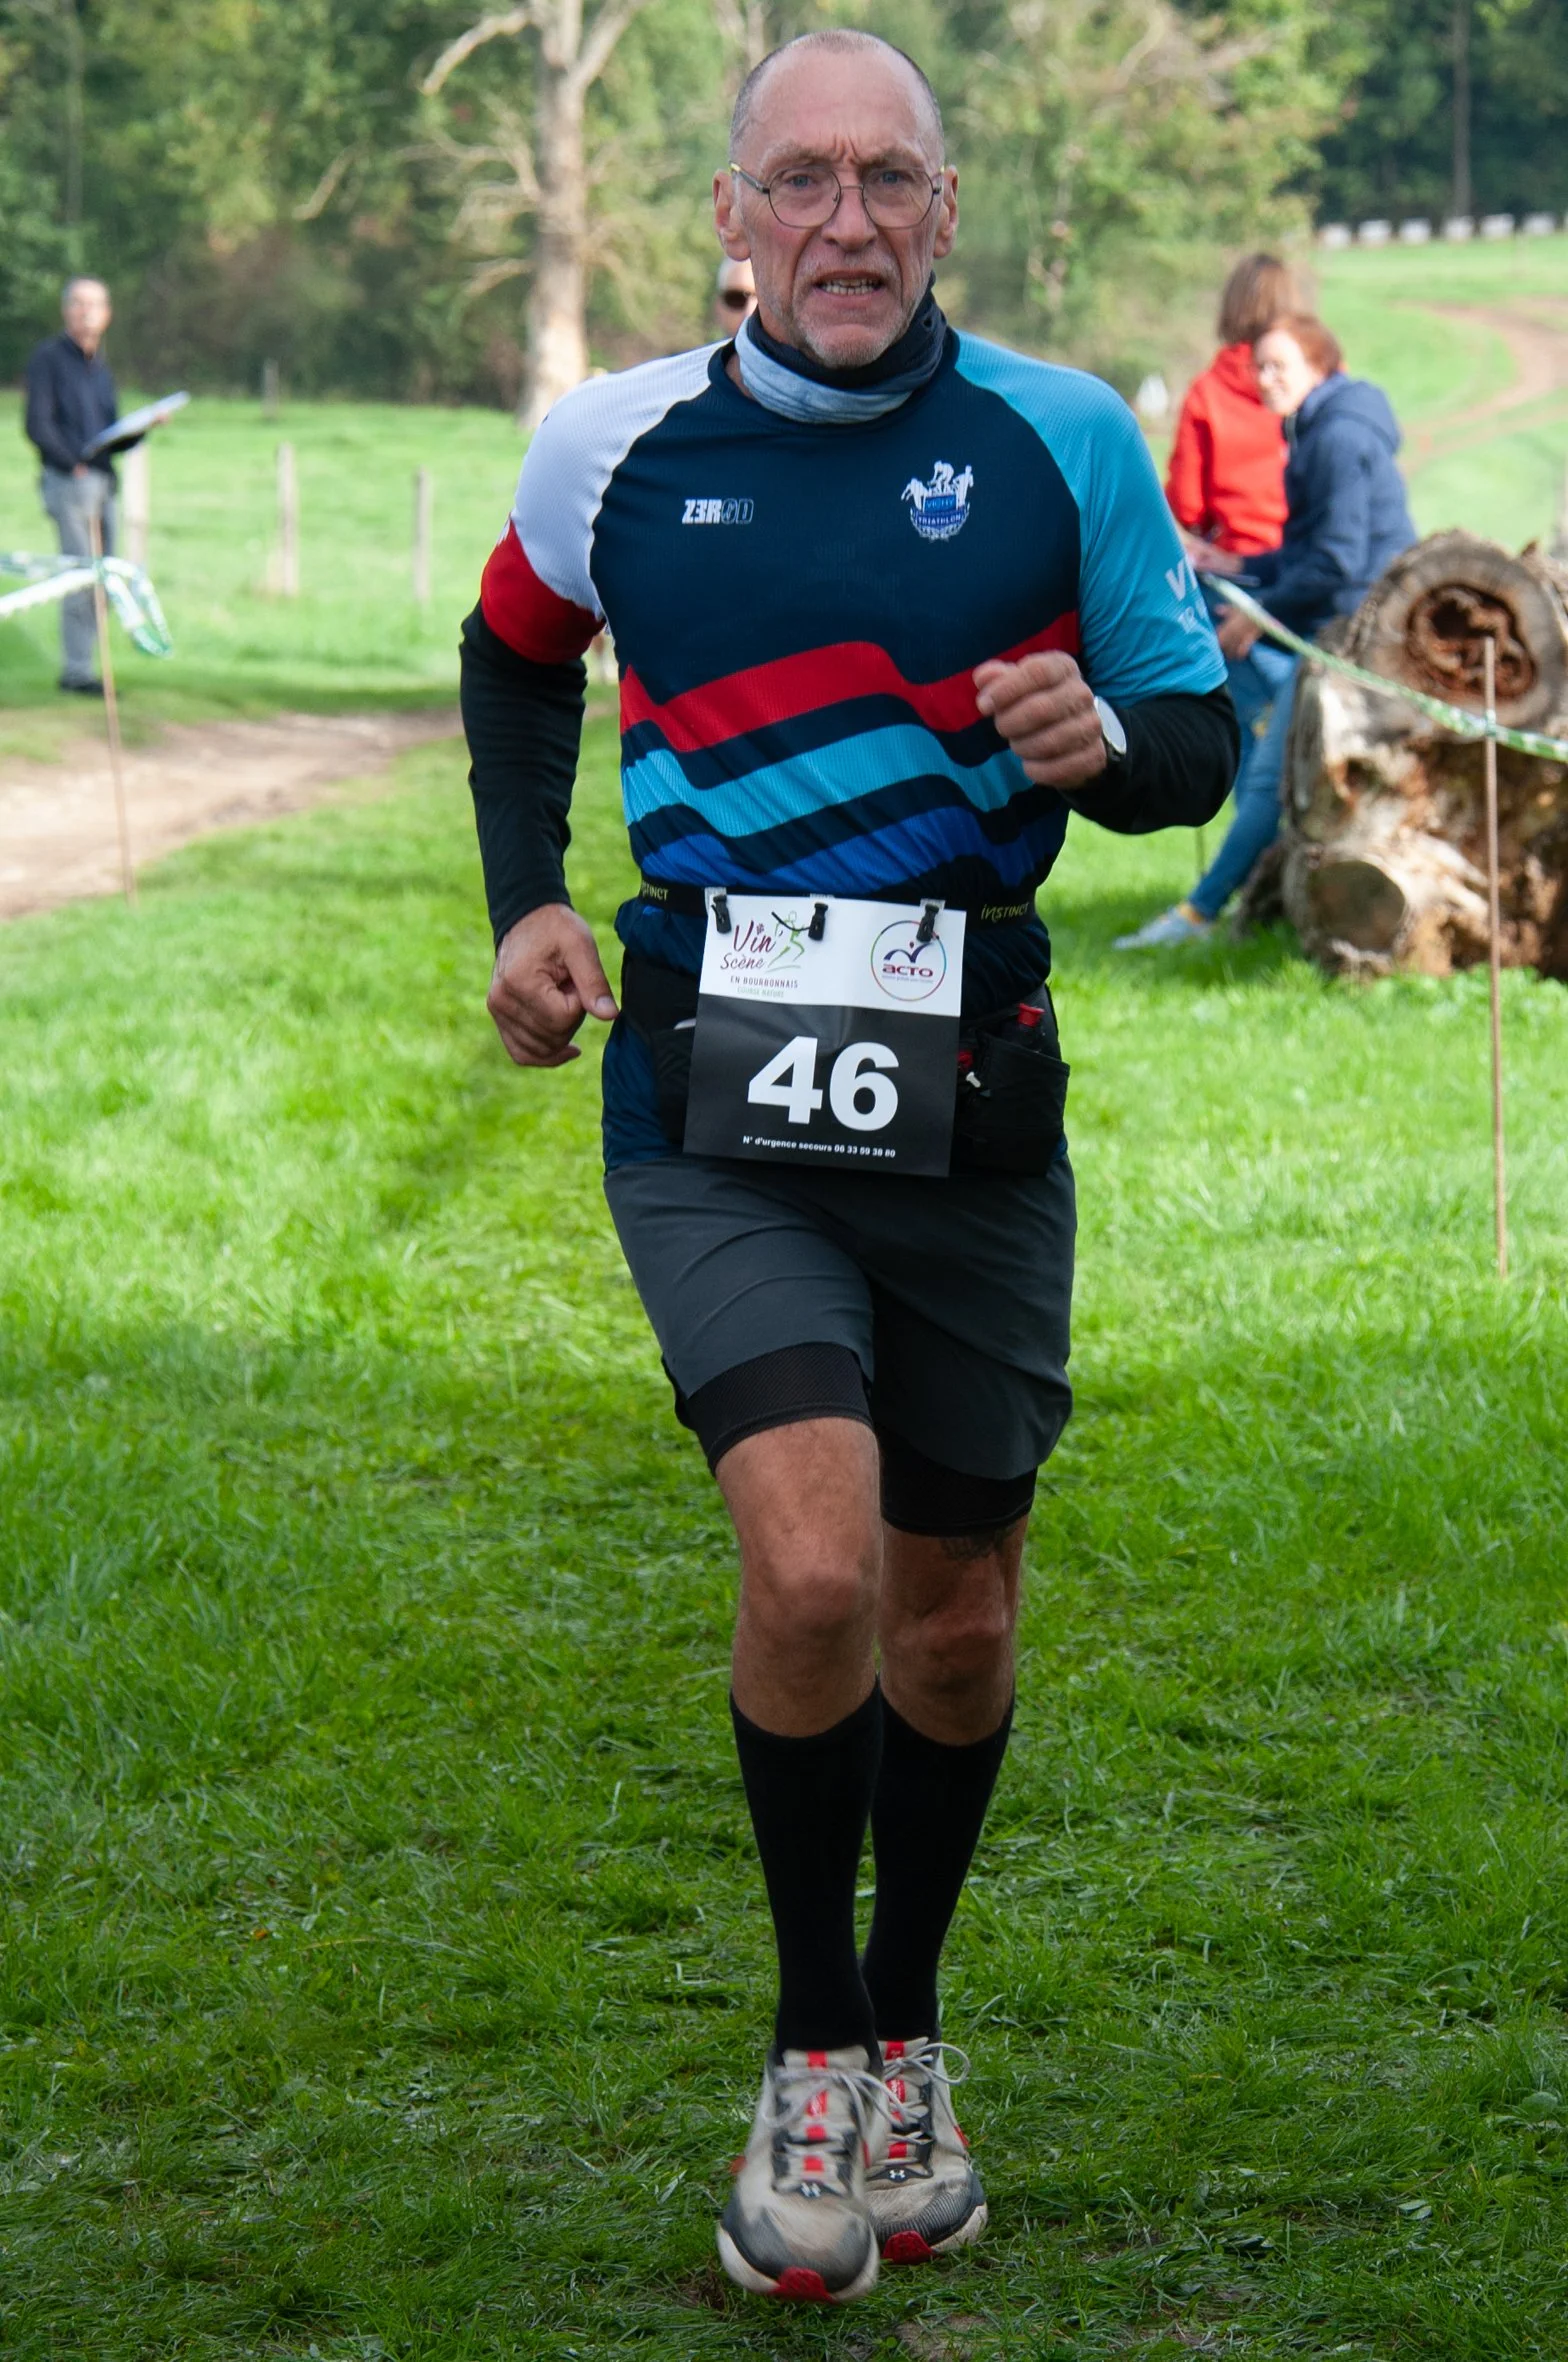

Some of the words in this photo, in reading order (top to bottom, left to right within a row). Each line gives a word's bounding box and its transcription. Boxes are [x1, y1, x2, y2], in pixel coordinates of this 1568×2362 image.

[720, 952, 765, 970] Scène
[747, 1035, 900, 1132] 46
[754, 1136, 797, 1150] d'urgence
[798, 1141, 833, 1153] secours
